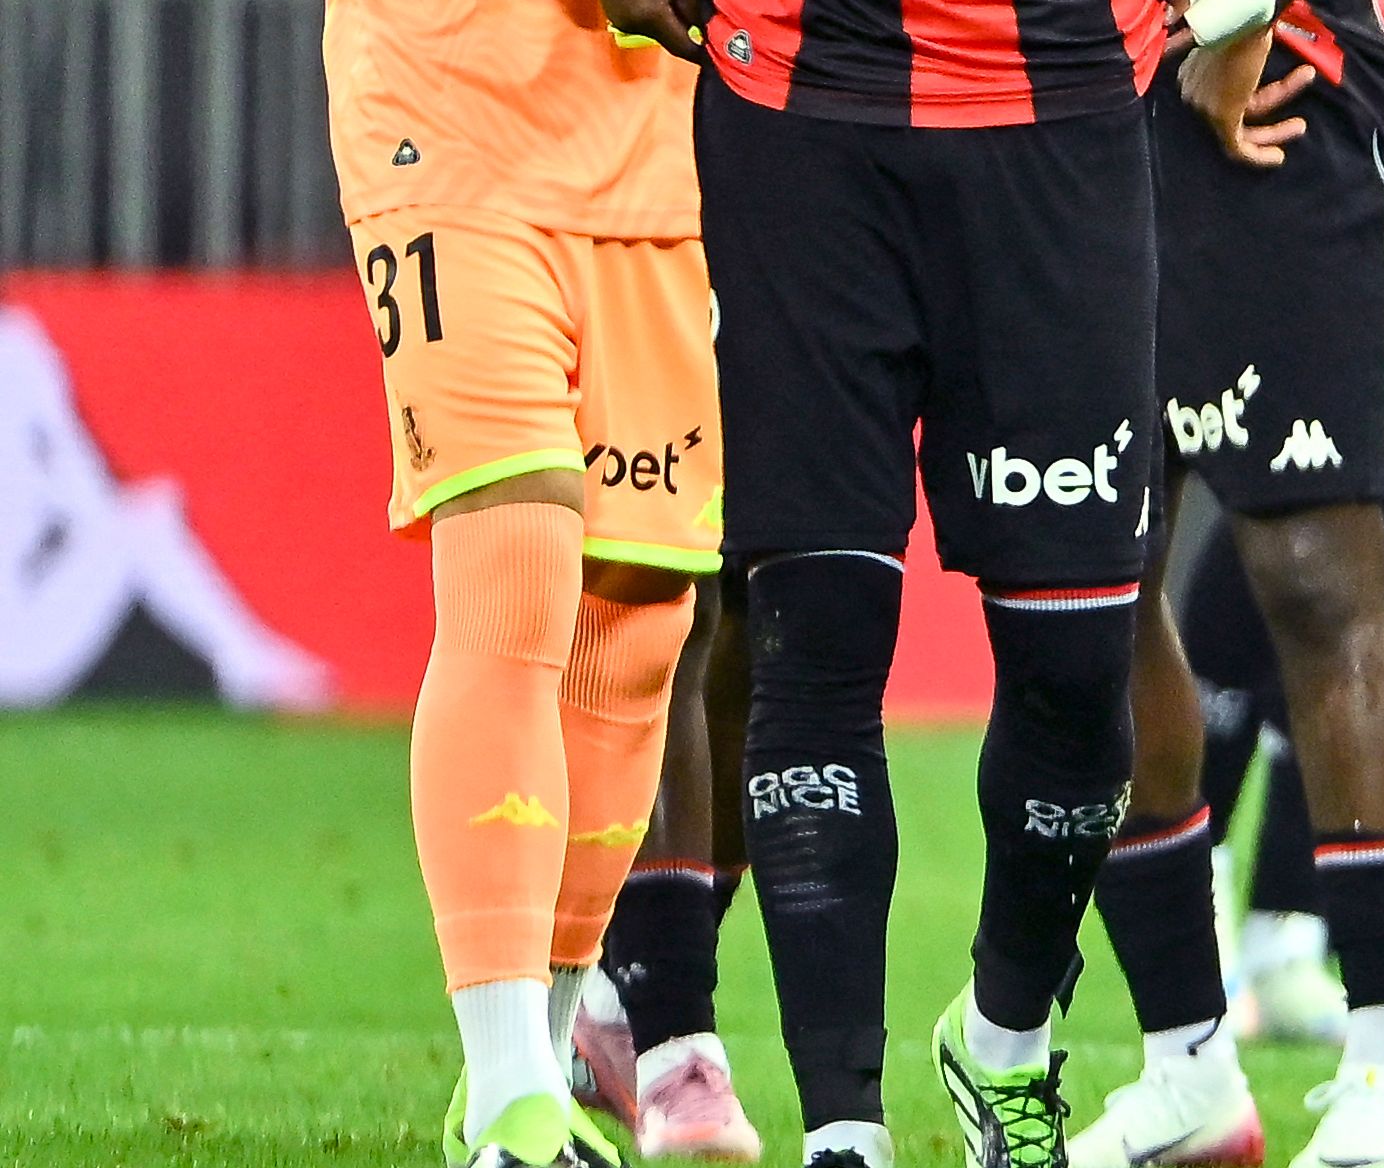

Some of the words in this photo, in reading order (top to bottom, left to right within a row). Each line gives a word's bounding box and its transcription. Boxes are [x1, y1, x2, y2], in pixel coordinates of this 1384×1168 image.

[366, 232, 443, 358] 31
[1163, 388, 1249, 454] bet
[966, 444, 1118, 507] vbet
[748, 764, 857, 797] OGC
[753, 785, 862, 819] NICE
